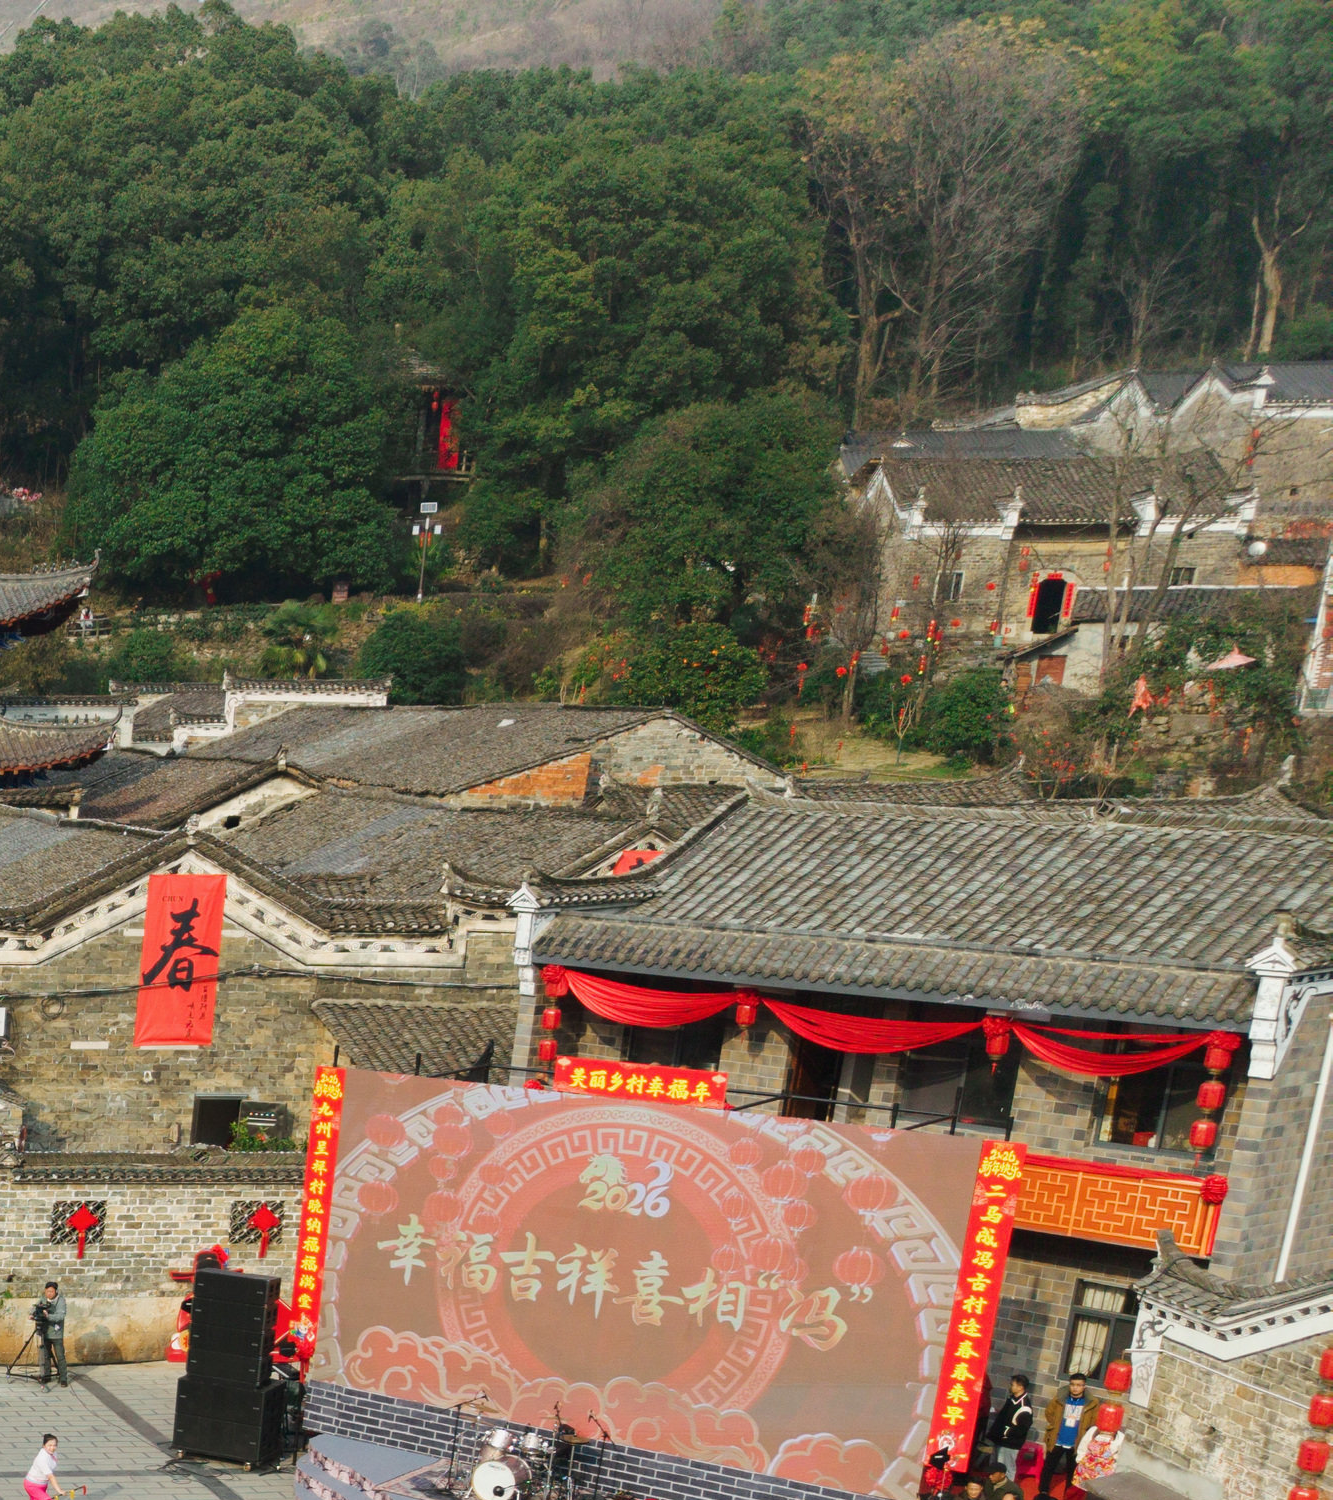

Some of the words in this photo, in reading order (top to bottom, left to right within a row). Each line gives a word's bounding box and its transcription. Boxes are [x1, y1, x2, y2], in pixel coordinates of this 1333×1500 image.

[142, 898, 219, 992] 春
[569, 1067, 711, 1103] 美丽乡村幸福年
[296, 1100, 334, 1310] 九州呈祥村晚纳福福满堂
[577, 1178, 671, 1218] 2026
[940, 1184, 1008, 1426] 二马成冯古村逢春春来早
